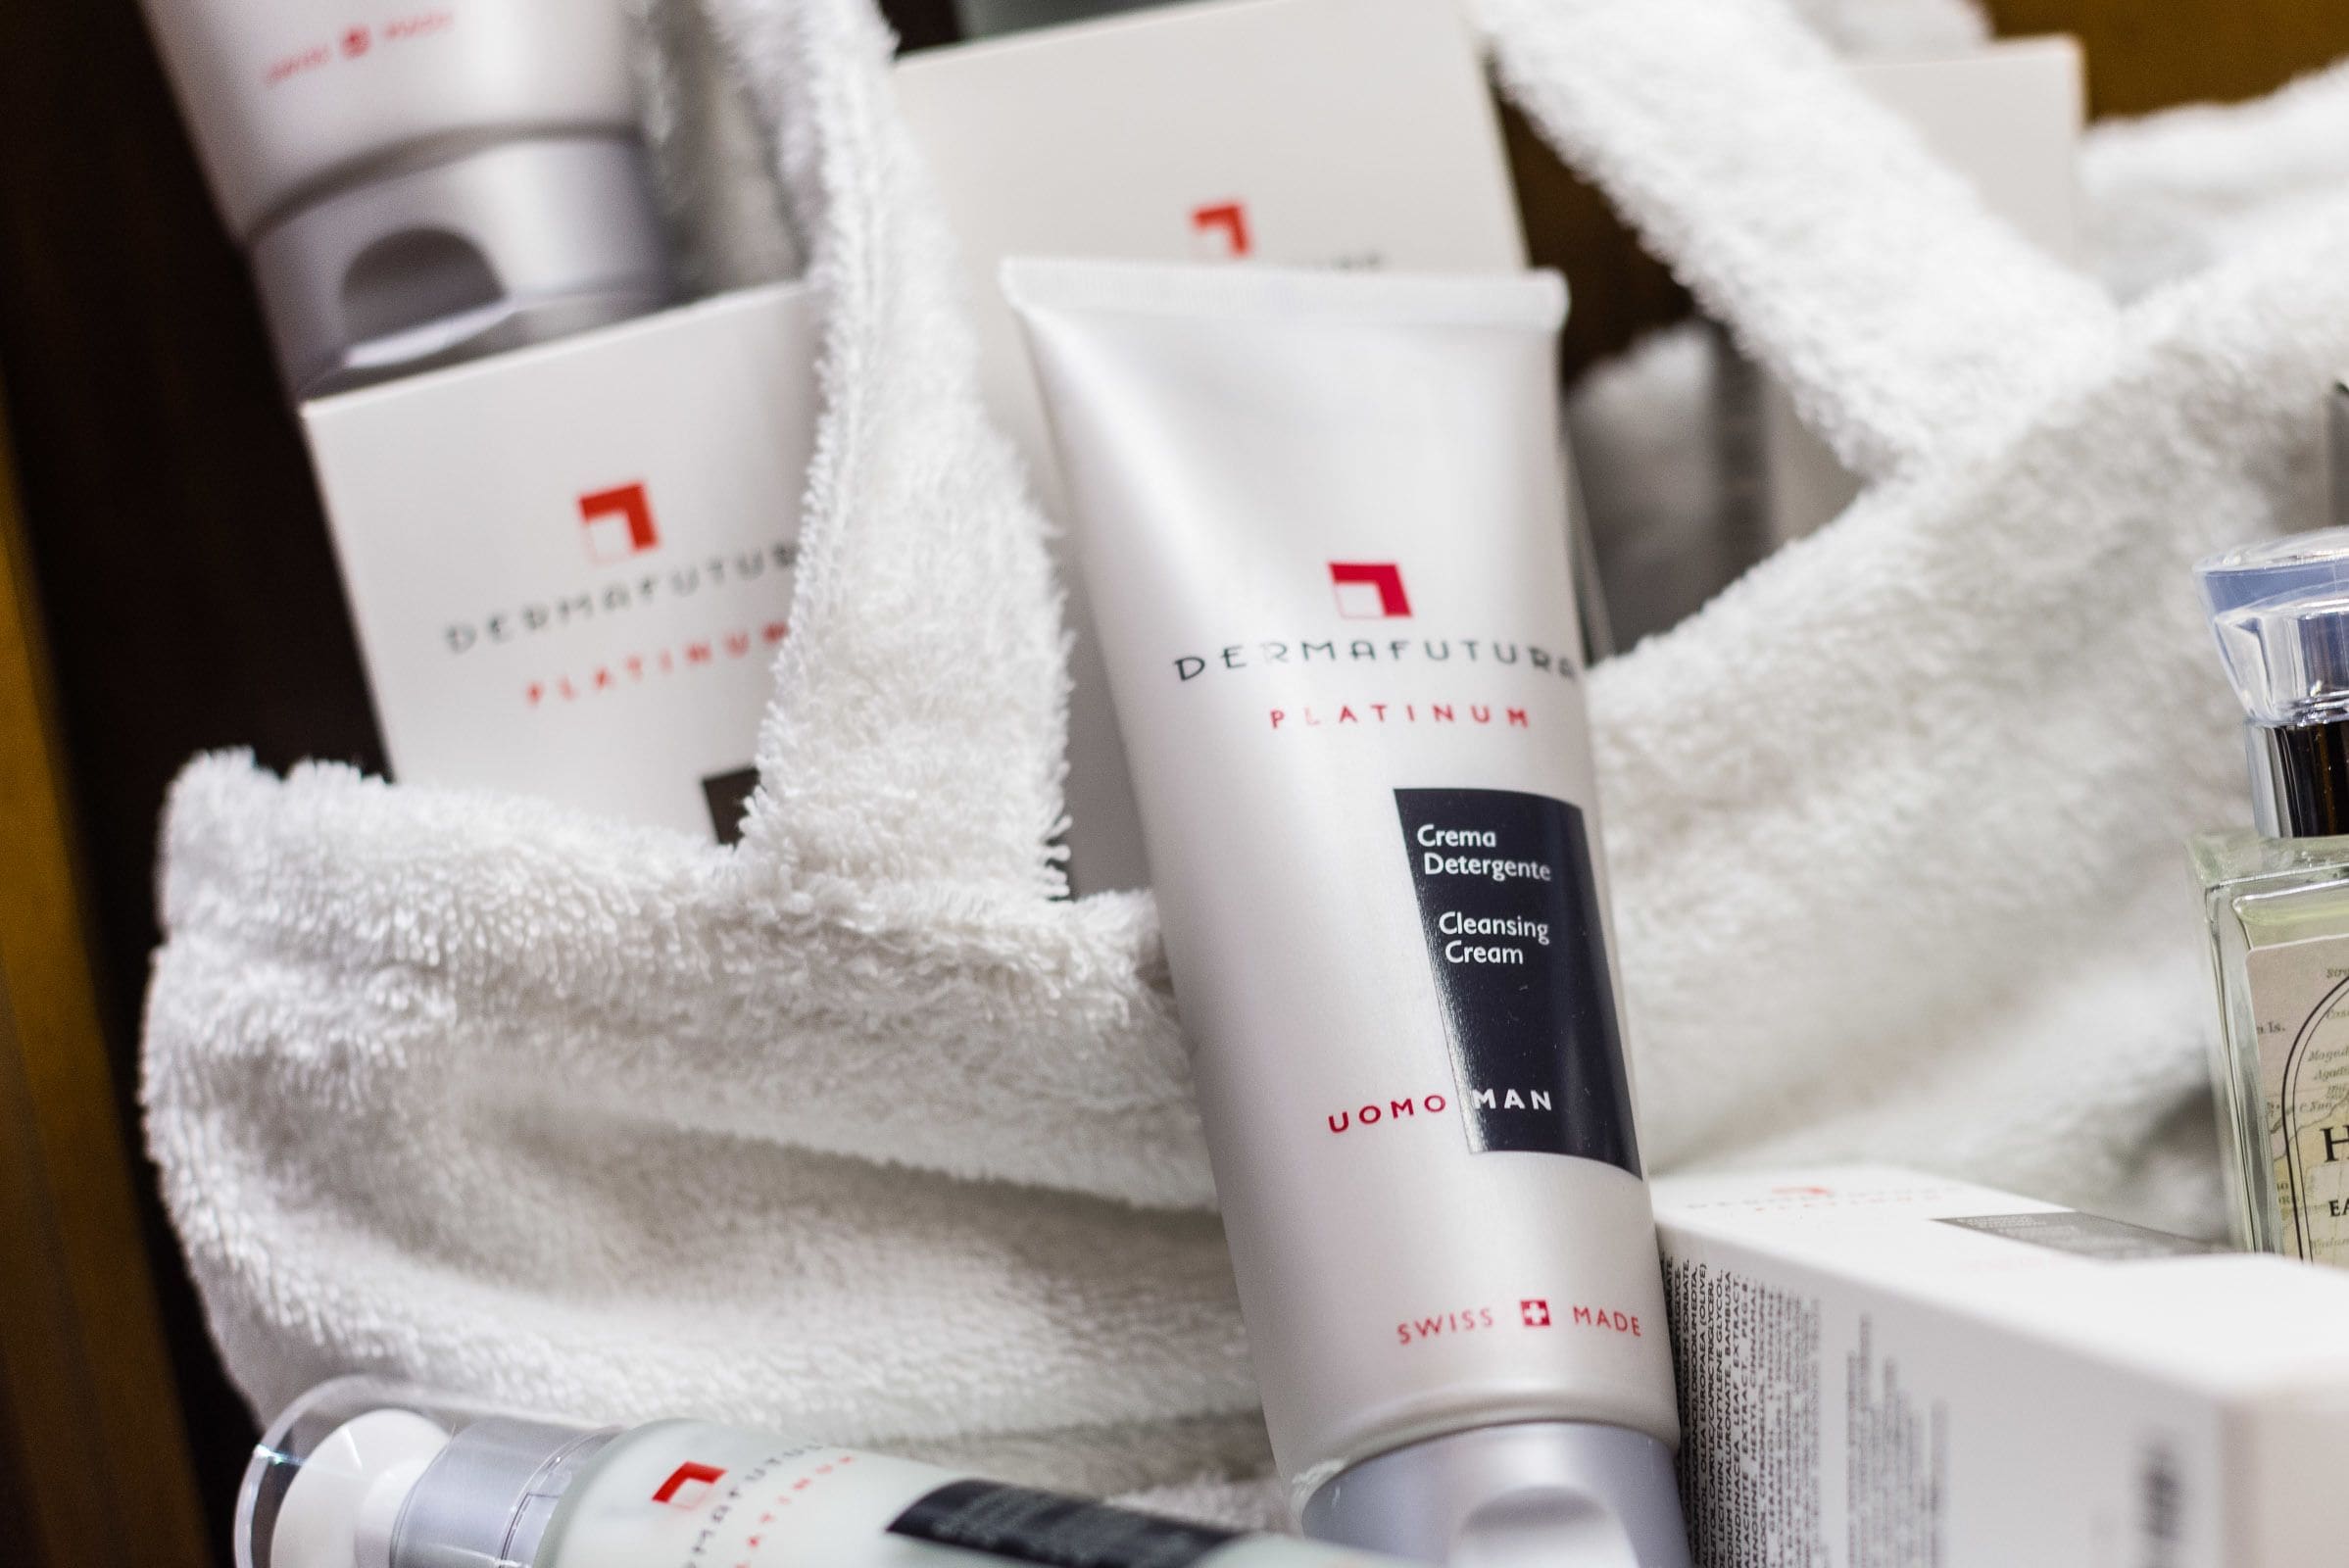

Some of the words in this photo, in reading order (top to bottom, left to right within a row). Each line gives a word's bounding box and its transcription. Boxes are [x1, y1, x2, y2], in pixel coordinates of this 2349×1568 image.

[1173, 639, 1577, 682] DERMAFUTURA
[1270, 704, 1530, 730] PLATINUM
[1417, 824, 1496, 848] Crema
[1424, 853, 1551, 881] Detergente
[1439, 911, 1550, 945] Cleansing
[1444, 940, 1524, 964] Cream
[1328, 1095, 1446, 1135] UOMO
[1471, 1088, 1552, 1111] MAN
[1396, 1307, 1494, 1346] SWISS
[1573, 1305, 1642, 1338] MADE
